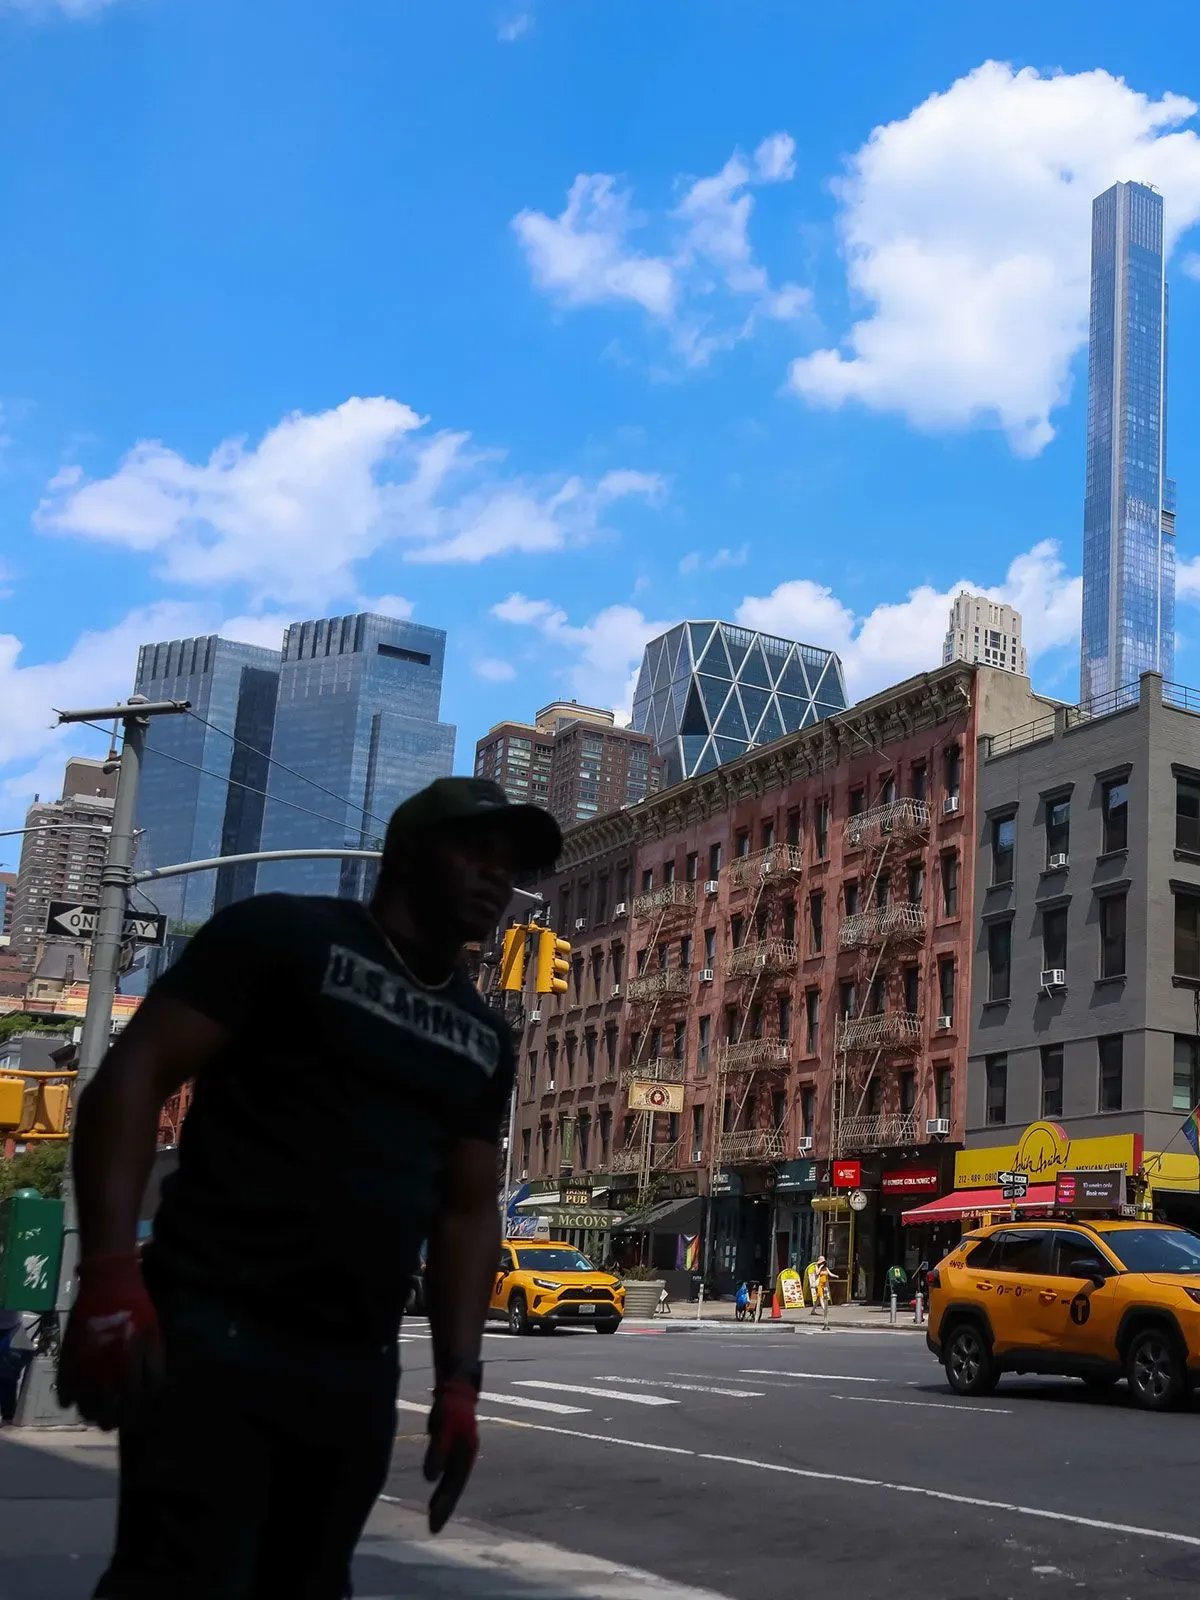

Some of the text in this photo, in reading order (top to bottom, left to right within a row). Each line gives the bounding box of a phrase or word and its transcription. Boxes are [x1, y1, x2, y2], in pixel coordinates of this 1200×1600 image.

[70, 914, 100, 929] ON
[393, 986, 472, 1056] ARMY
[565, 1196, 587, 1204] PUB
[559, 1215, 608, 1227] McCOYS
